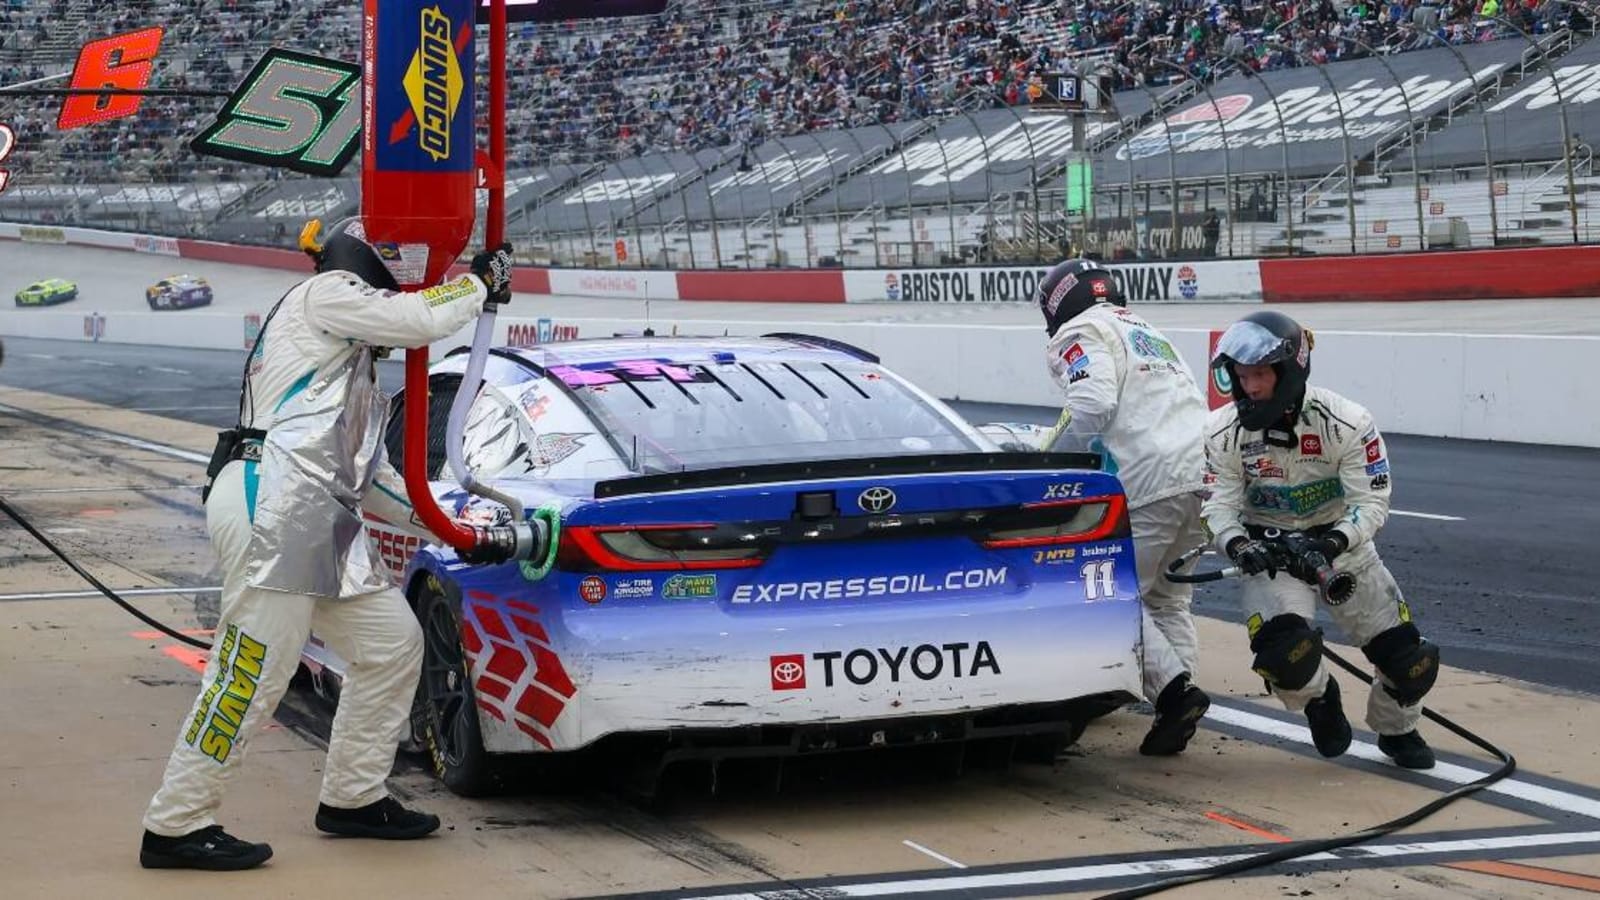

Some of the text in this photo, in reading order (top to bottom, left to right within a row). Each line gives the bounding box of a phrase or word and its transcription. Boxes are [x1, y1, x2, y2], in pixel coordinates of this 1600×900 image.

[58, 26, 164, 129] 6
[423, 15, 448, 153] SUNOCO
[207, 57, 361, 165] 51
[1222, 63, 1506, 132] Bristol
[902, 271, 975, 301] BRISTOL
[507, 324, 537, 347] FOOD
[1044, 483, 1085, 499] XSE
[1046, 548, 1076, 560] NTB
[614, 586, 653, 595] KINGDOM
[633, 579, 652, 587] TIRE
[691, 586, 711, 594] TIRE
[732, 567, 1008, 603] EXPRESSOIL.COM
[1080, 559, 1115, 602] 11
[812, 641, 1001, 688] TOYOTA
[200, 631, 268, 764] MAVIS
